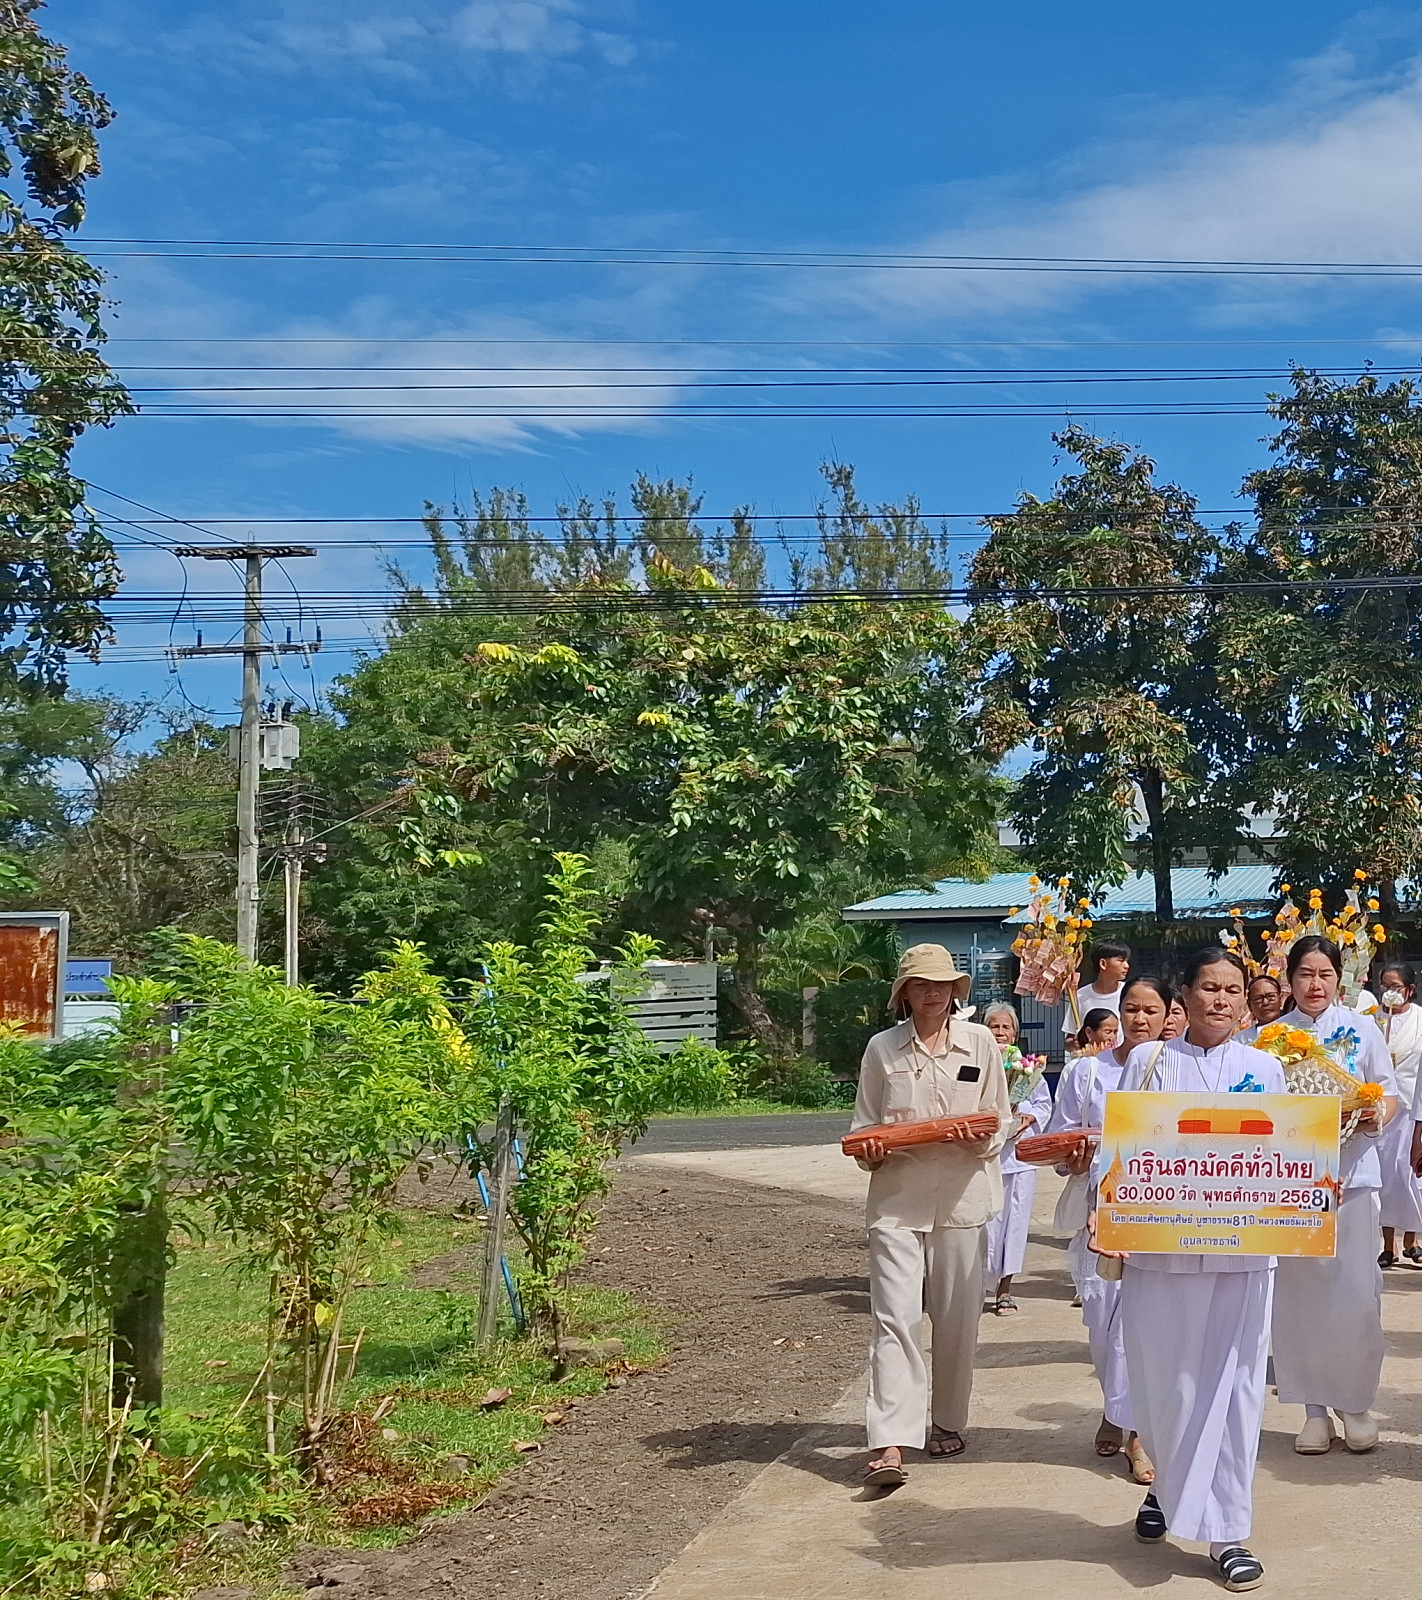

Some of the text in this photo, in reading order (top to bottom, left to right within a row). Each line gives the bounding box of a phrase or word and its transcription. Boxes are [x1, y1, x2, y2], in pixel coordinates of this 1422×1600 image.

[1128, 1145, 1313, 1184] กฐินสามัคคีทั่วไทย
[1118, 1186, 1175, 1203] 30,000
[1178, 1184, 1197, 1201] วัด
[1202, 1187, 1276, 1208] พุทธศักราช
[1179, 1235, 1240, 1249] (อุบลราชธานี)
